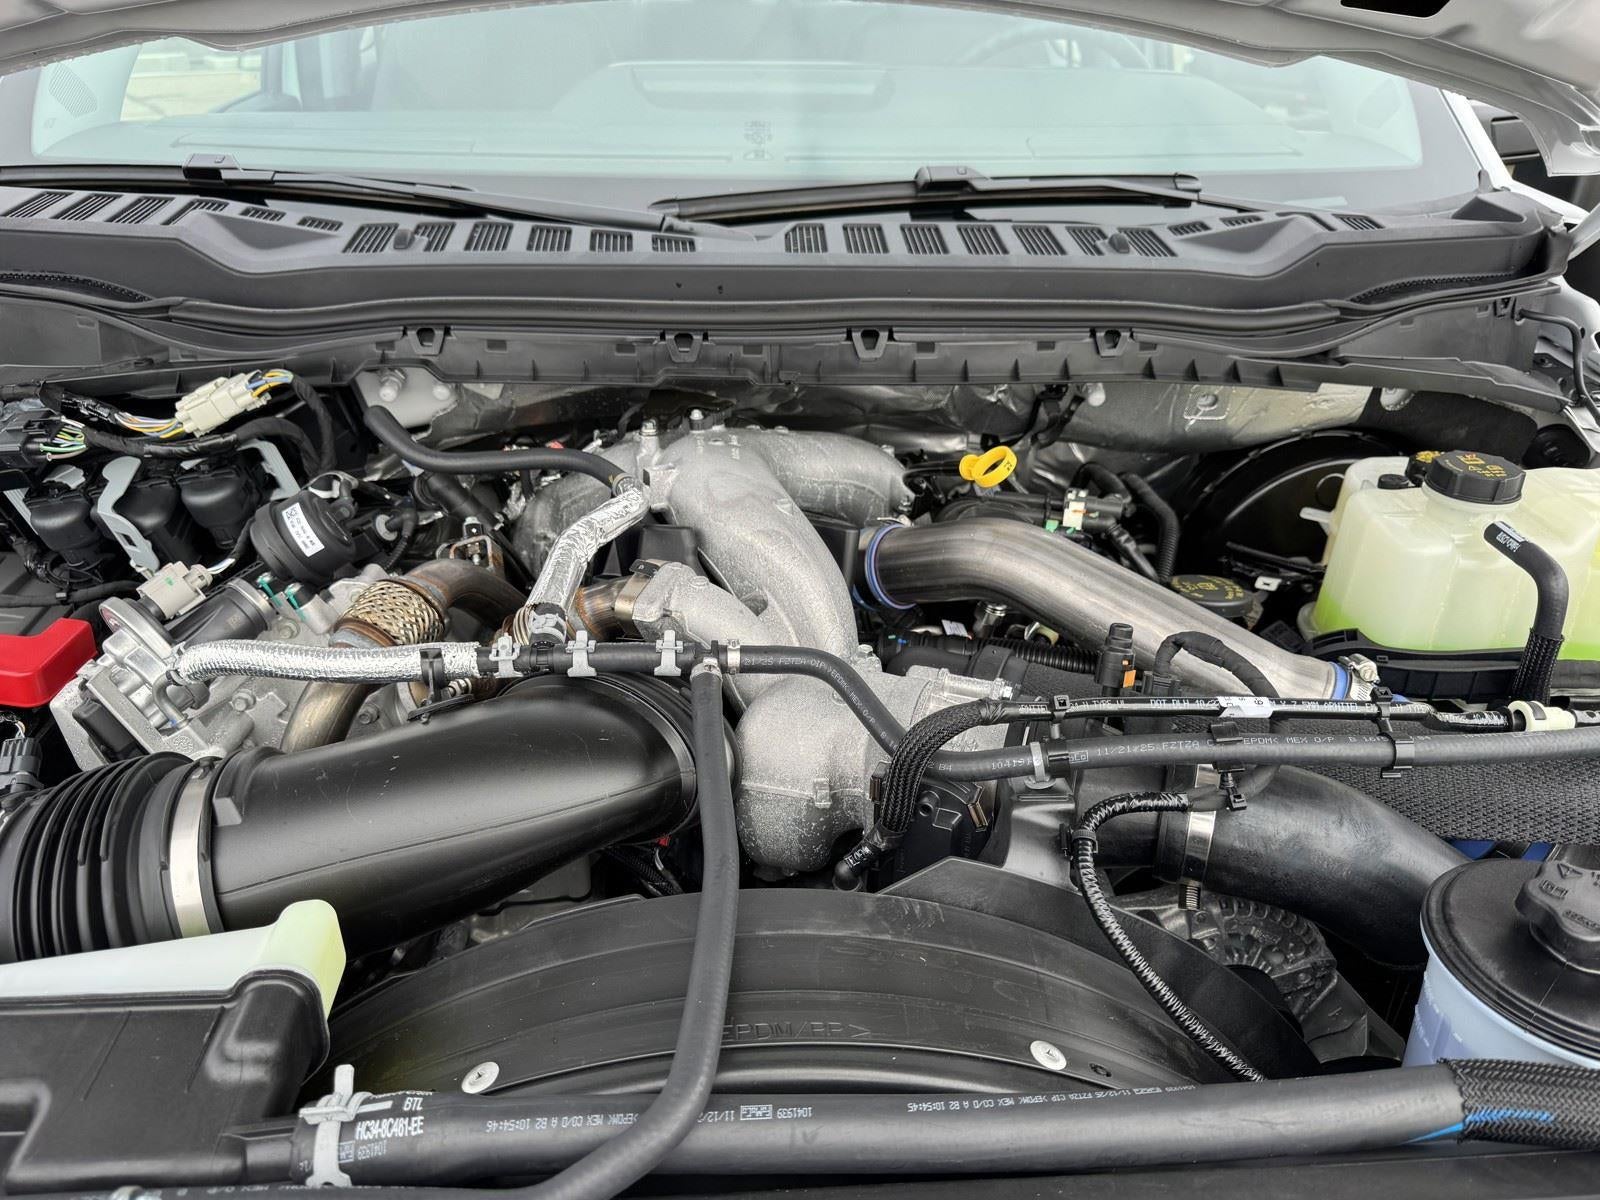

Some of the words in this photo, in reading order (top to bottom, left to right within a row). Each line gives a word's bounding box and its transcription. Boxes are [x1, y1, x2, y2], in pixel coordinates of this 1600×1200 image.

[1286, 736, 1308, 744] MEX
[907, 1102, 945, 1113] 10:54:45
[997, 1097, 1014, 1107] MEX
[777, 1106, 813, 1119] 1041939
[486, 1119, 530, 1132] 10:54:46
[587, 1114, 604, 1126] MEX
